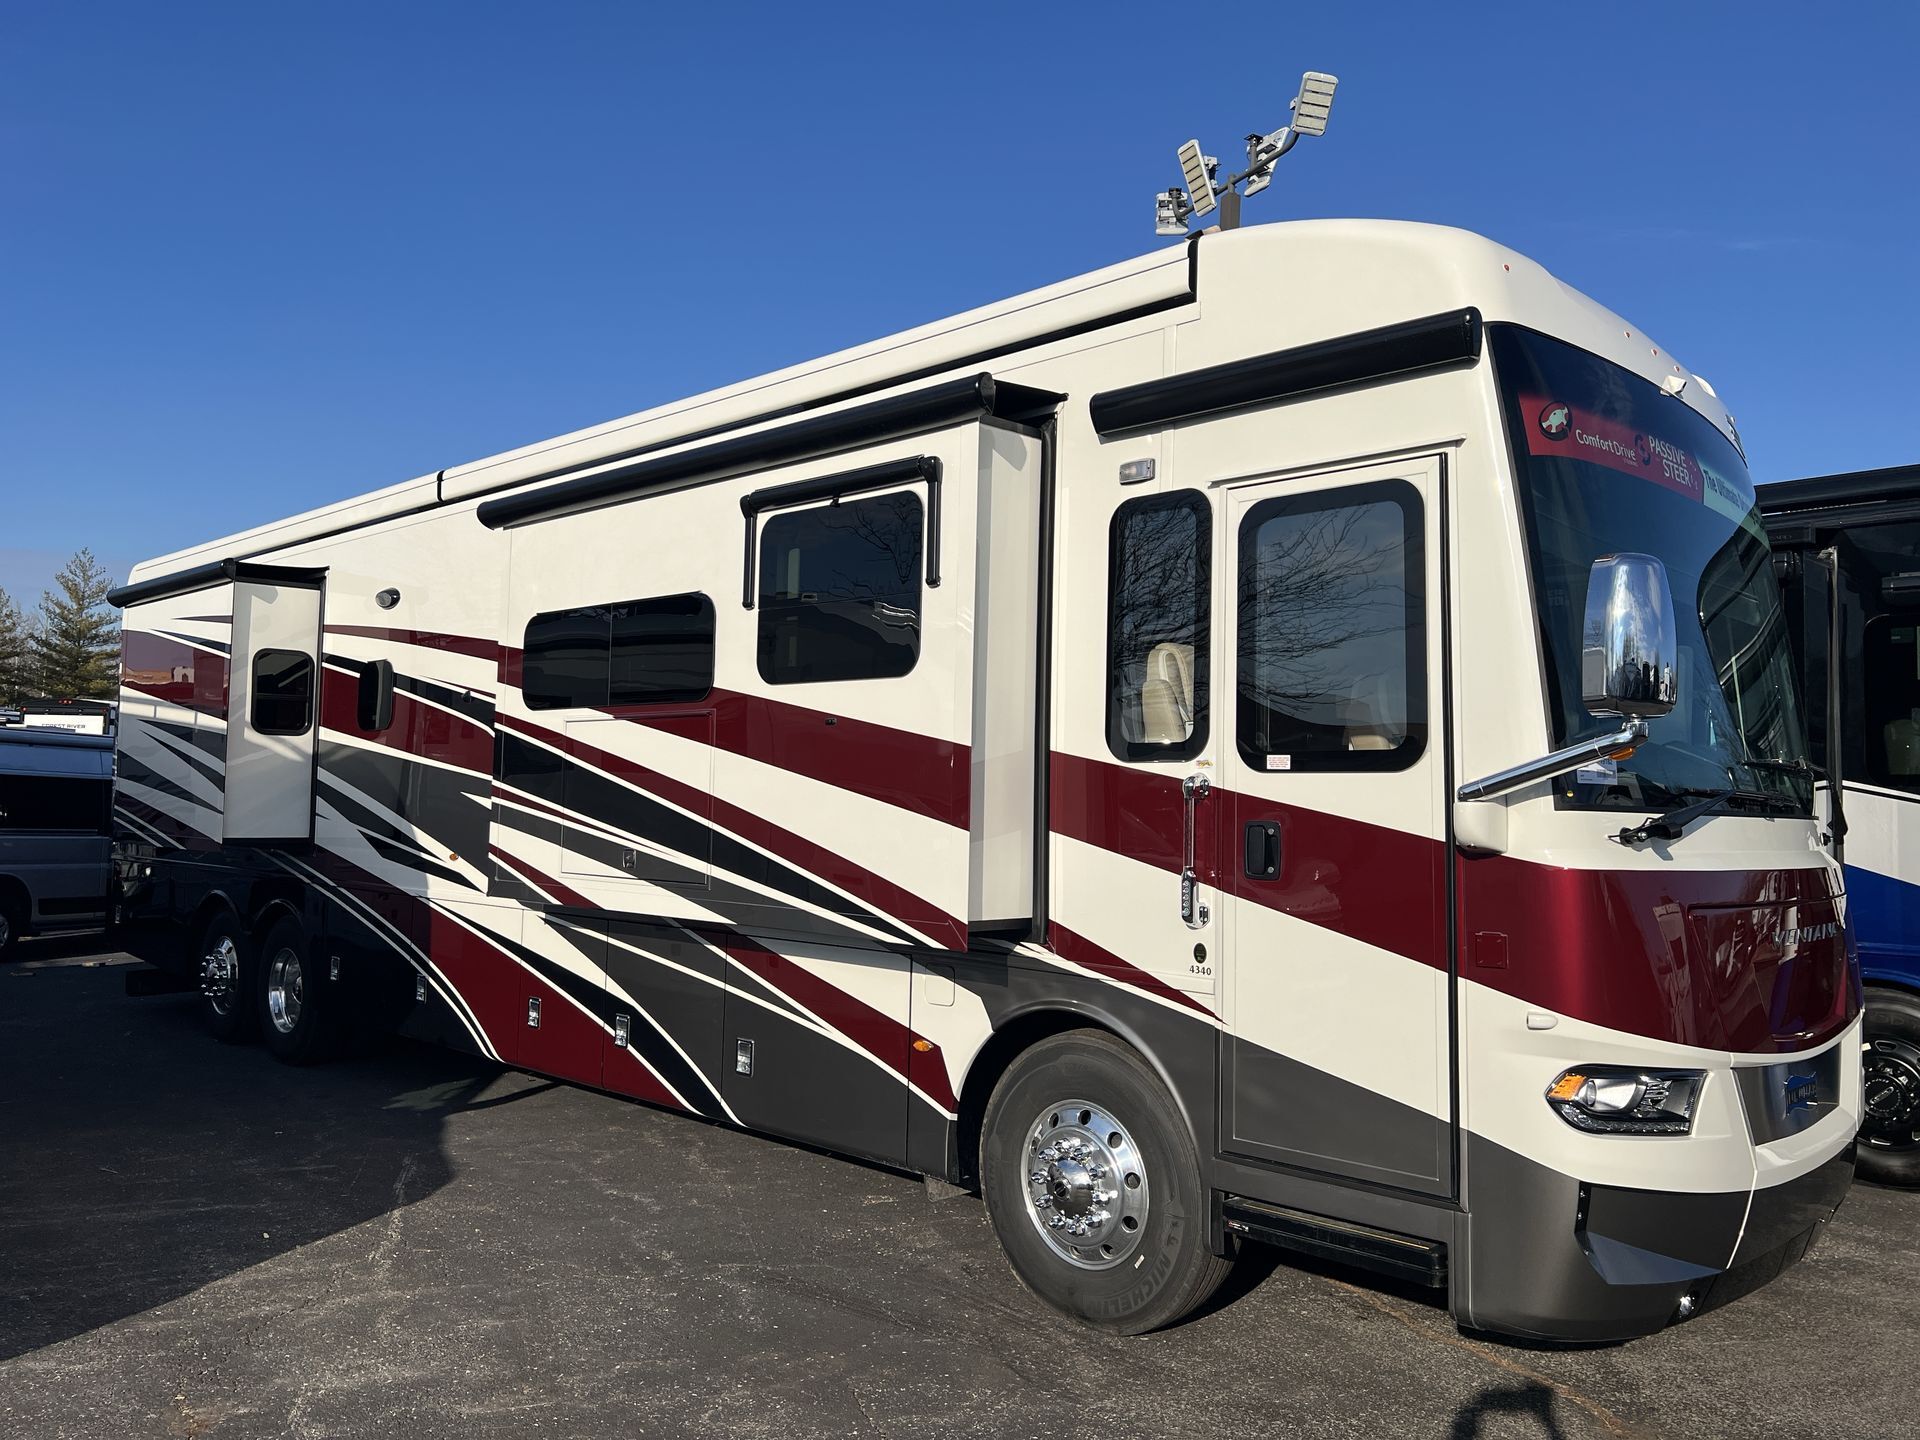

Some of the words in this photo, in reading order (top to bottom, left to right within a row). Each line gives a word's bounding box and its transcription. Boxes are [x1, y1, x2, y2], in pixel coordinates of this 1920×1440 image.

[1648, 435, 1687, 467] PASSIVE
[1663, 459, 1692, 488] STEER
[1702, 468, 1718, 494] The
[1189, 965, 1212, 976] 4340
